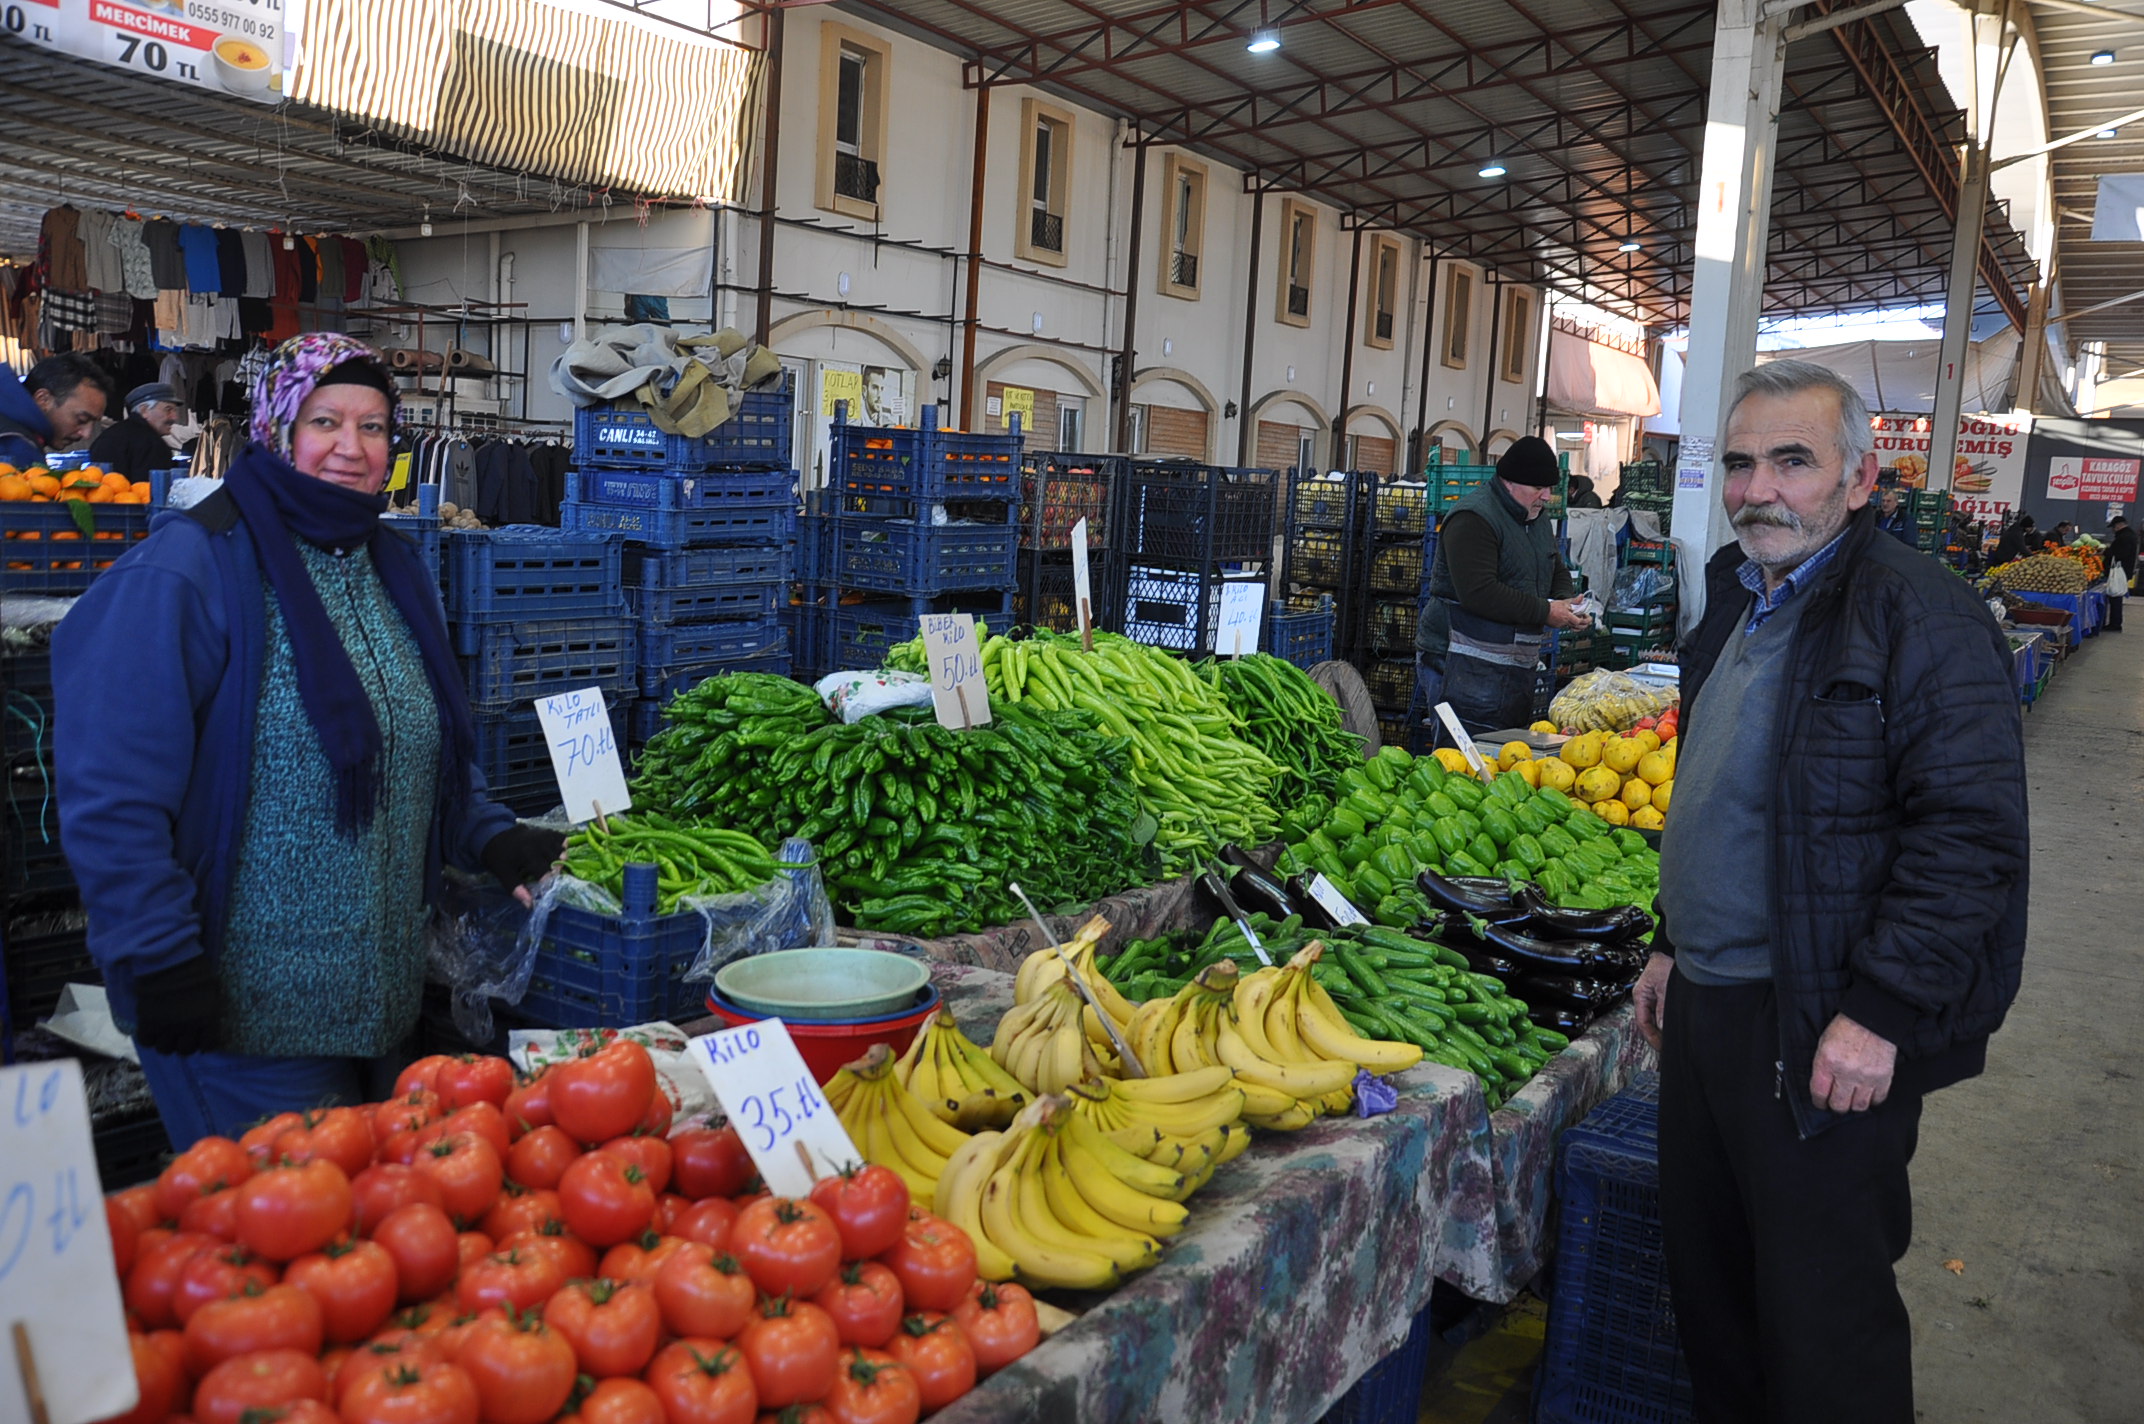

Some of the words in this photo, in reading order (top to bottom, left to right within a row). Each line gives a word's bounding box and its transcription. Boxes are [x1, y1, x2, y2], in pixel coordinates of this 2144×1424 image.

[95, 3, 192, 42] MERCİMEK
[188, 2, 219, 24] 0555
[220, 11, 241, 30] 977
[242, 17, 257, 36] 00
[258, 23, 275, 40] 92
[32, 22, 54, 43] TL
[115, 32, 168, 72] 70
[176, 61, 201, 81] TL
[1947, 362, 1955, 380] 1
[598, 427, 634, 444] CANLI
[2089, 460, 2132, 473] KARAGÖZ
[2081, 473, 2137, 486] TAVUKÇULUK
